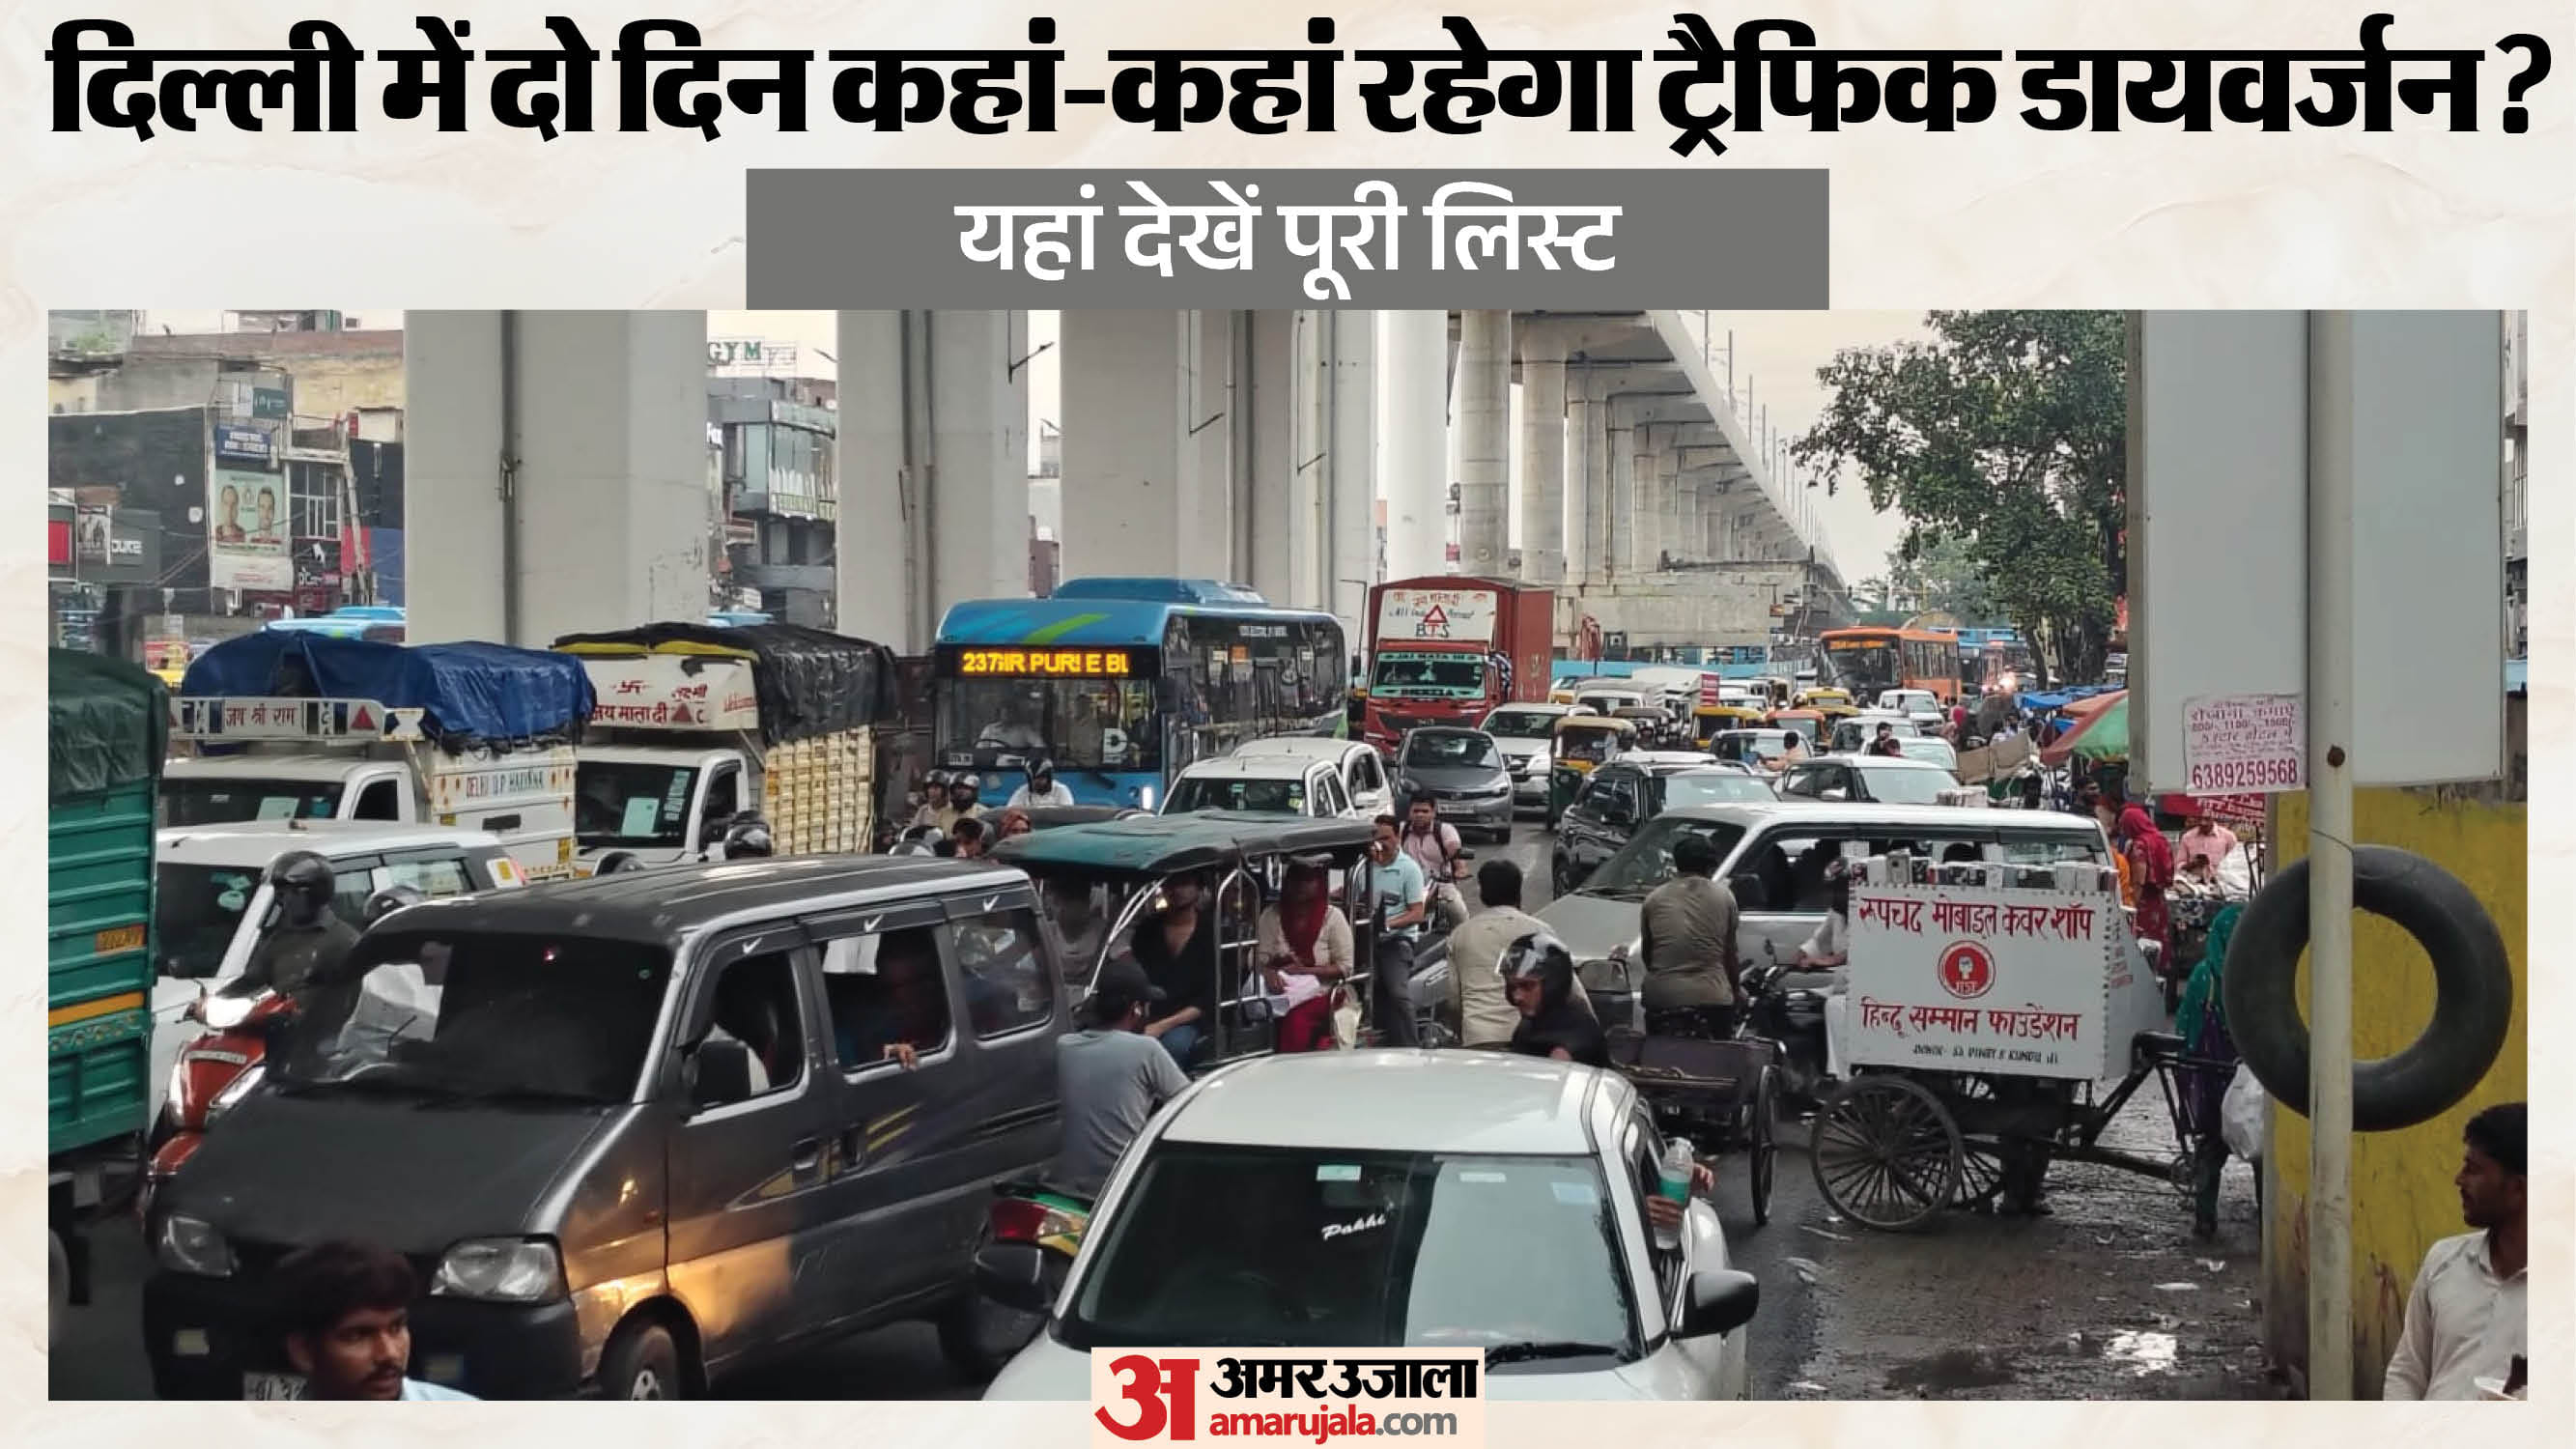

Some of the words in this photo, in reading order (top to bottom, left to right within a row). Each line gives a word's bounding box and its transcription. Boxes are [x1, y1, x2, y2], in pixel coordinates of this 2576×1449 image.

[707, 341, 762, 365] GYM
[1086, 653, 1102, 673] E
[224, 706, 247, 727] जय
[251, 702, 268, 726] श्री
[272, 706, 298, 726] राम
[618, 705, 651, 724] माता
[652, 702, 668, 724] दी
[2193, 757, 2298, 789] 6389259568
[2001, 904, 2049, 937] कवर
[2051, 902, 2095, 940] शॉप
[1909, 1006, 1981, 1035] सम्मान
